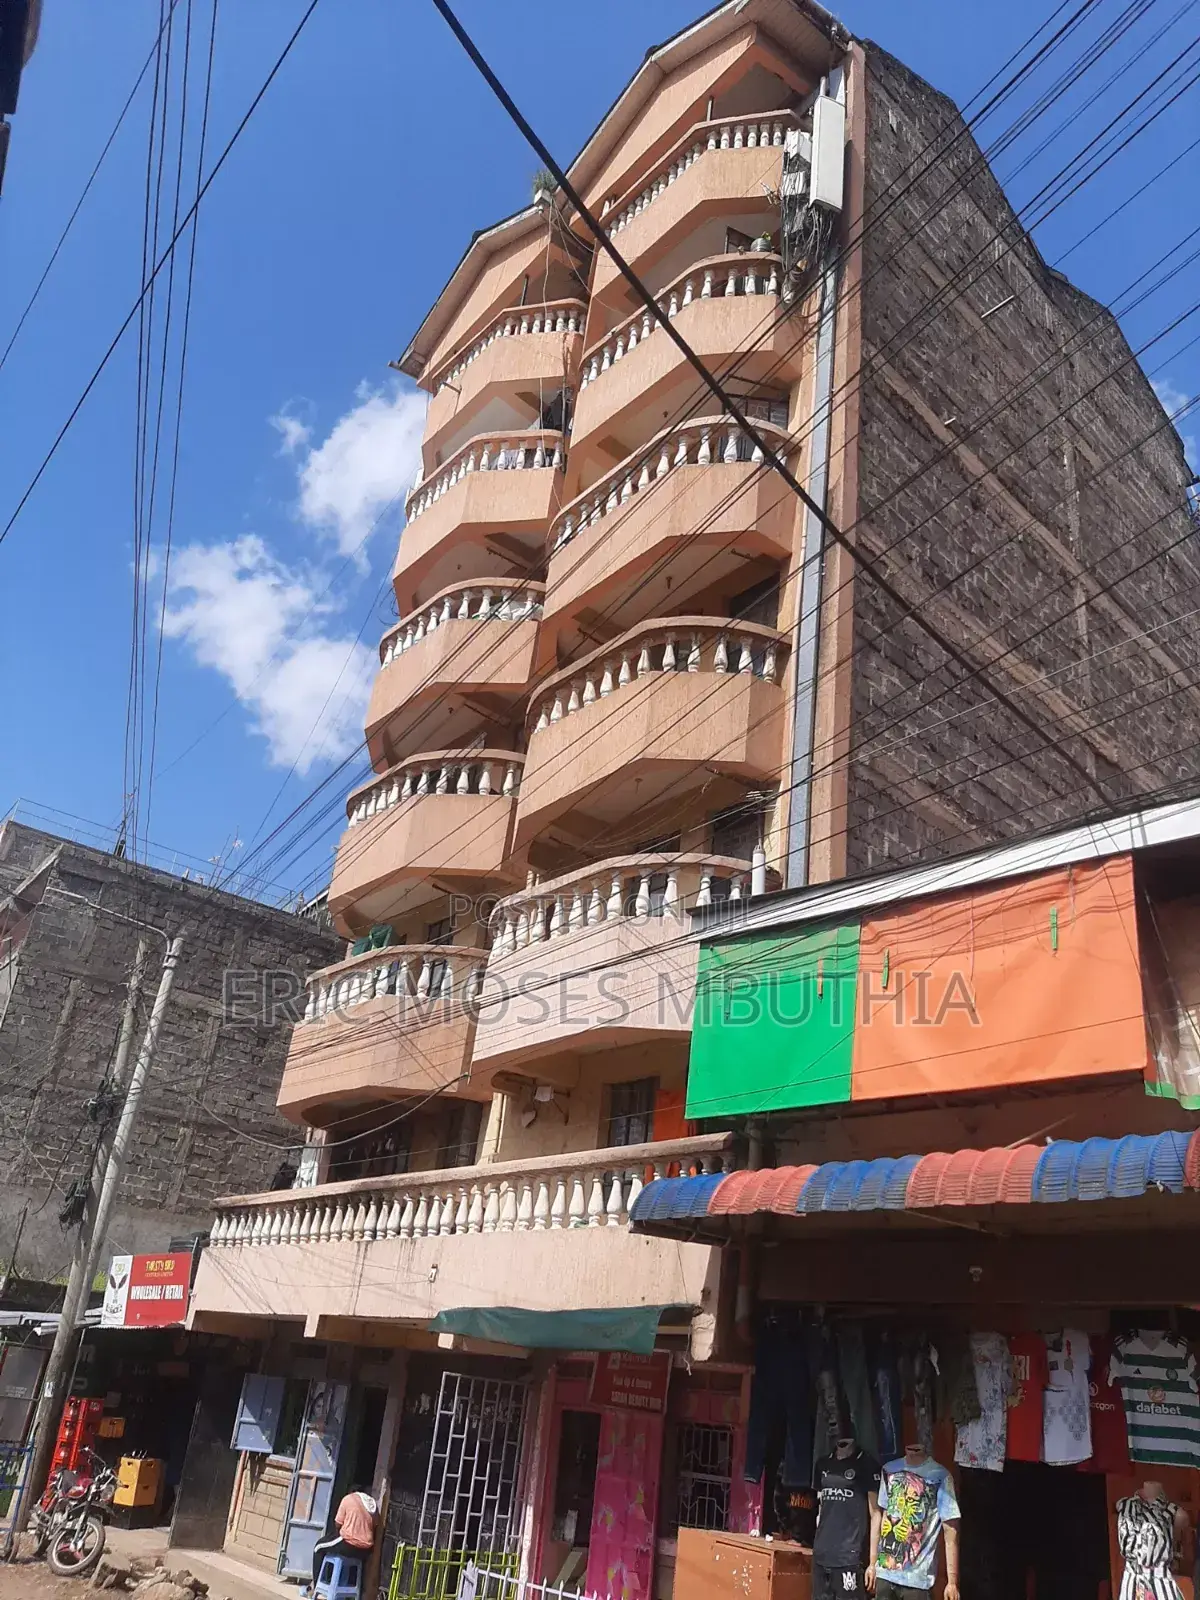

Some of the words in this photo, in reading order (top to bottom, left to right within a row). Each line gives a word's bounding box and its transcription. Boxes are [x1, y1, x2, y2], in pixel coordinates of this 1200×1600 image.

[131, 1286, 162, 1300] WHOLESALE
[165, 1284, 184, 1300] RETAIL
[1136, 1402, 1182, 1415] dafabet
